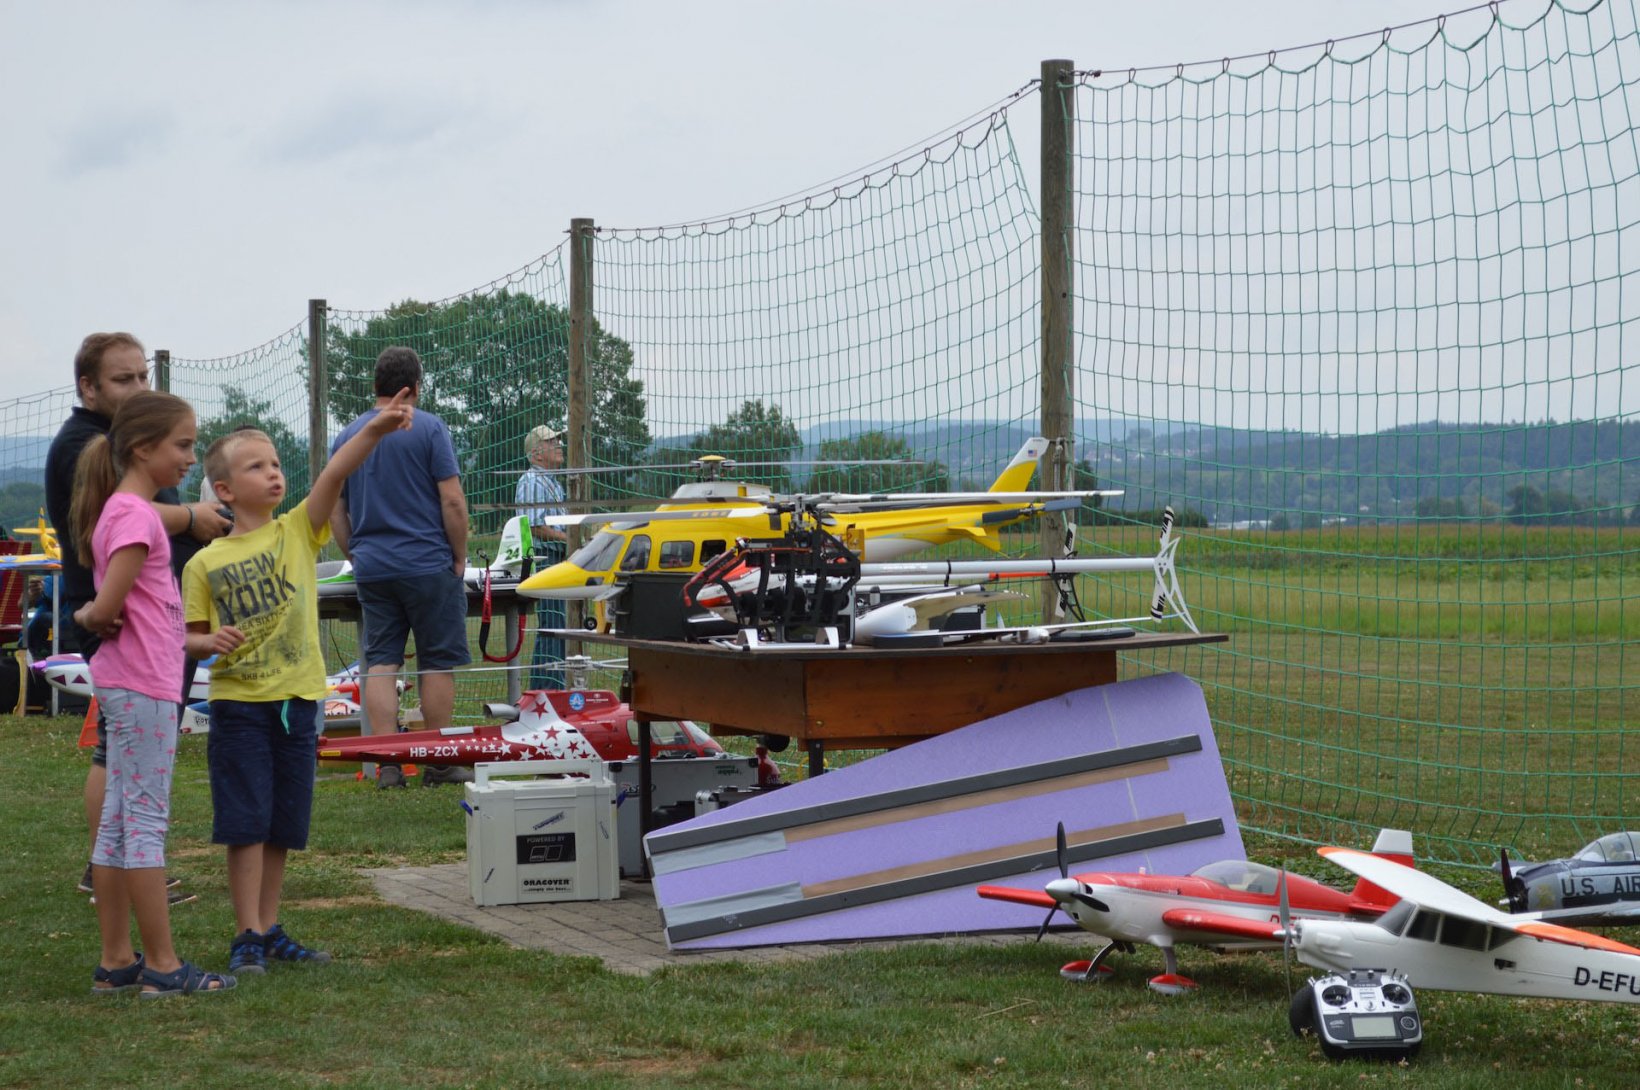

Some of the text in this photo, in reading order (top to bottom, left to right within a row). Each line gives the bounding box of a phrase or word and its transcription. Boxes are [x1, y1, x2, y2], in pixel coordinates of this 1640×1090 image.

[504, 547, 520, 561] 24
[222, 551, 276, 589] NEW
[215, 564, 296, 626] YORK
[409, 745, 459, 757] HB-ZCX
[1561, 877, 1599, 897] U.S.
